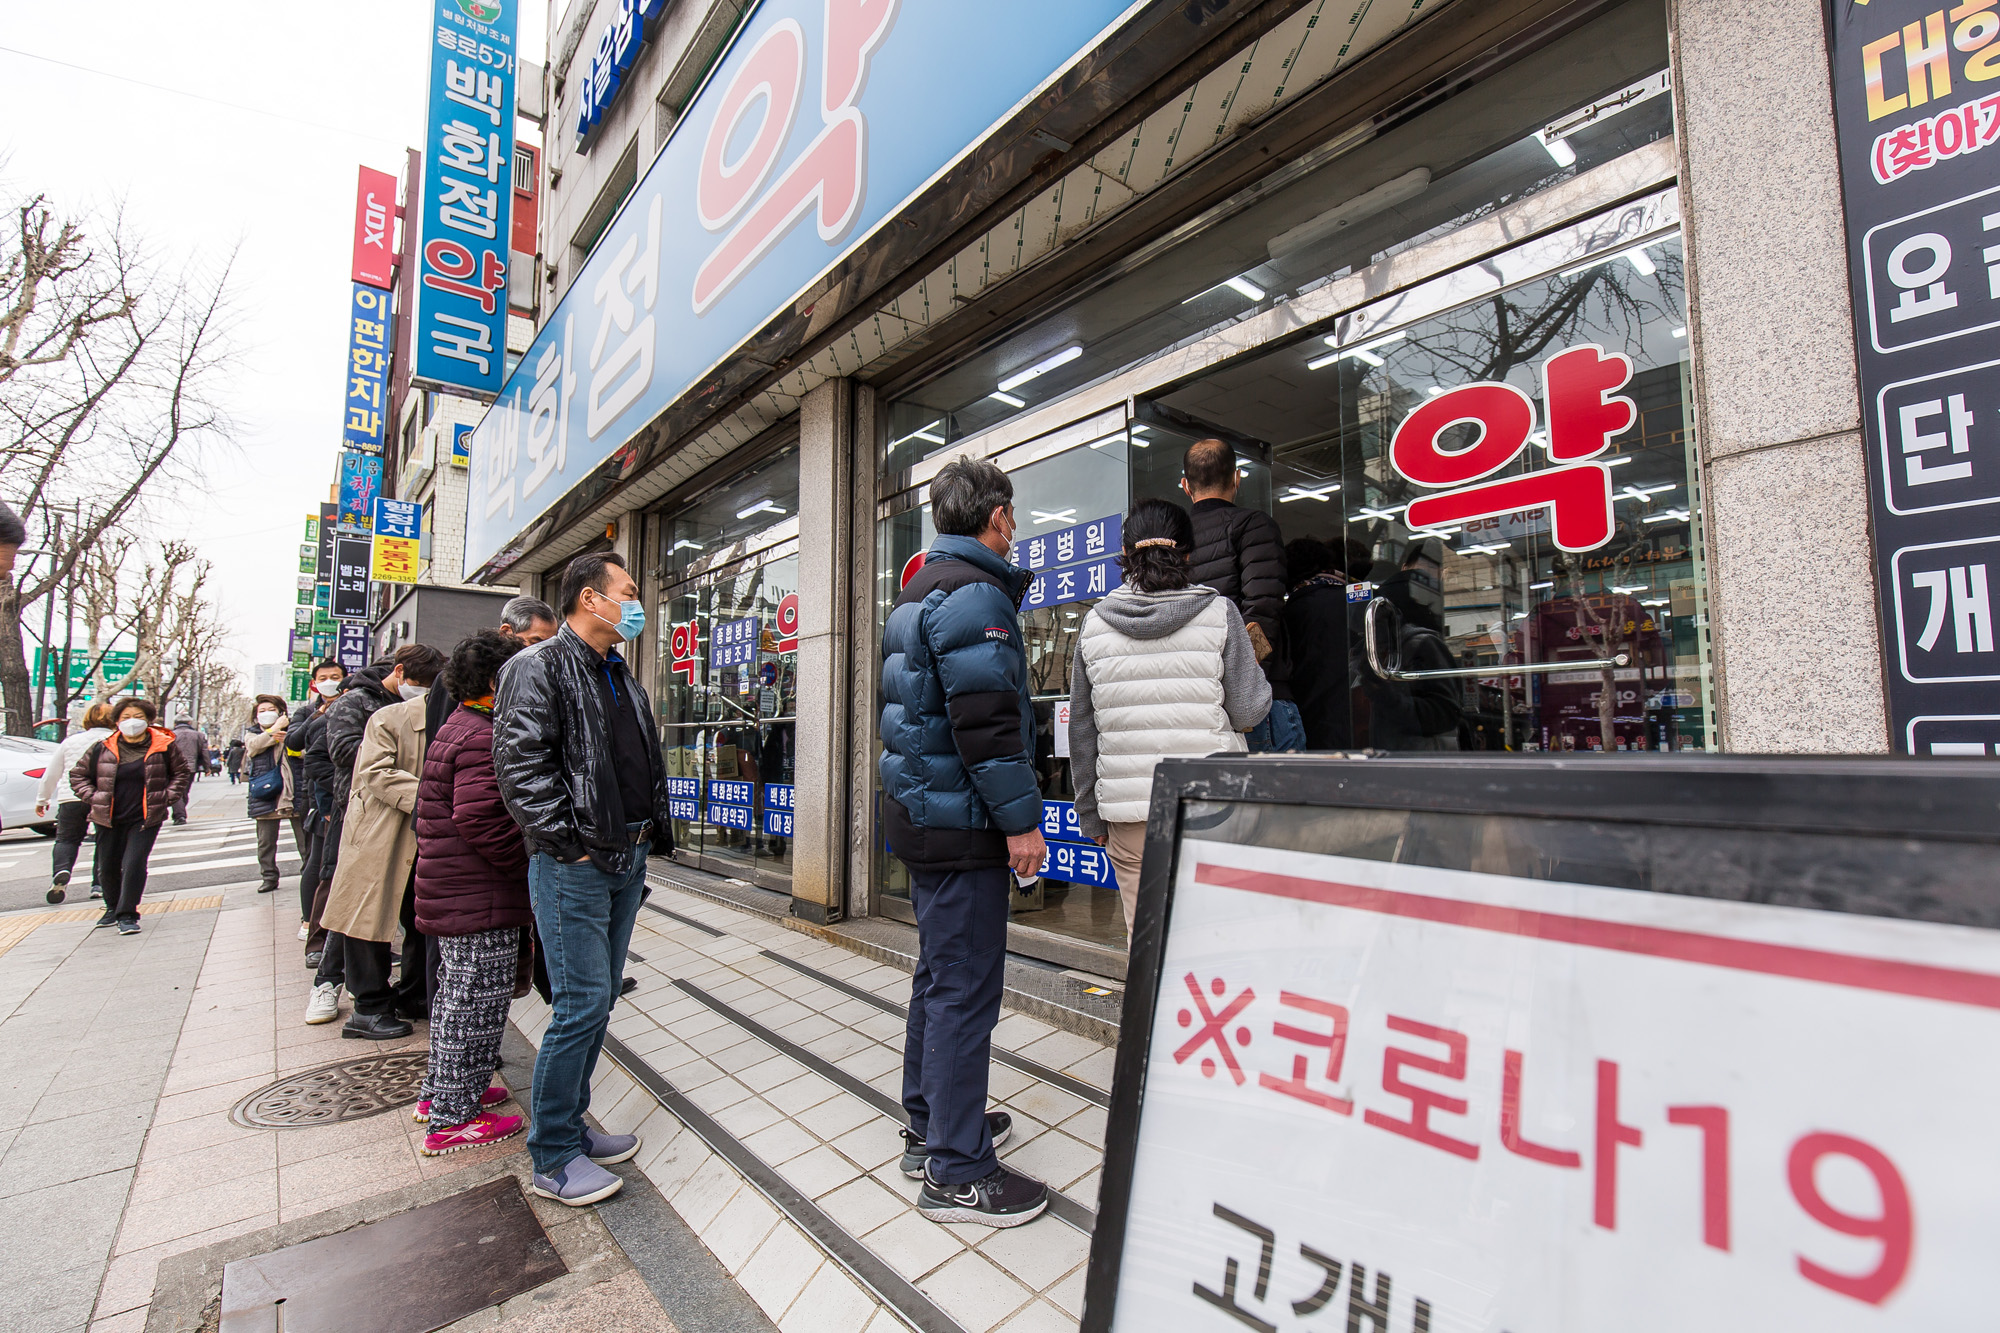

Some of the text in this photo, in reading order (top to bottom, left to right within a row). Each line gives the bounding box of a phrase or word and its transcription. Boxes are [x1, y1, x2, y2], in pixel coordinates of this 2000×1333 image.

[437, 25, 514, 75] 종로5가
[363, 192, 386, 250] JDX
[346, 290, 386, 437] 이편한치과
[343, 440, 382, 452] 41-8887
[1389, 342, 1637, 553] 약
[346, 456, 382, 475] 키움
[350, 476, 375, 515] 참치
[343, 512, 373, 529] 초밥
[381, 500, 415, 537] 행정사
[379, 538, 413, 573] 부동산
[340, 564, 367, 578] 벨라
[372, 573, 416, 583] 2269-3357
[339, 579, 365, 593] 노래
[1912, 563, 1994, 653] 개
[716, 619, 754, 645] 종합병원
[985, 631, 1009, 641] MILLET
[341, 625, 365, 667] 고시텔
[670, 618, 699, 687] 약
[715, 643, 753, 667] 처방조제
[712, 782, 749, 803] 백화점약국
[711, 805, 748, 828] (마장약국)
